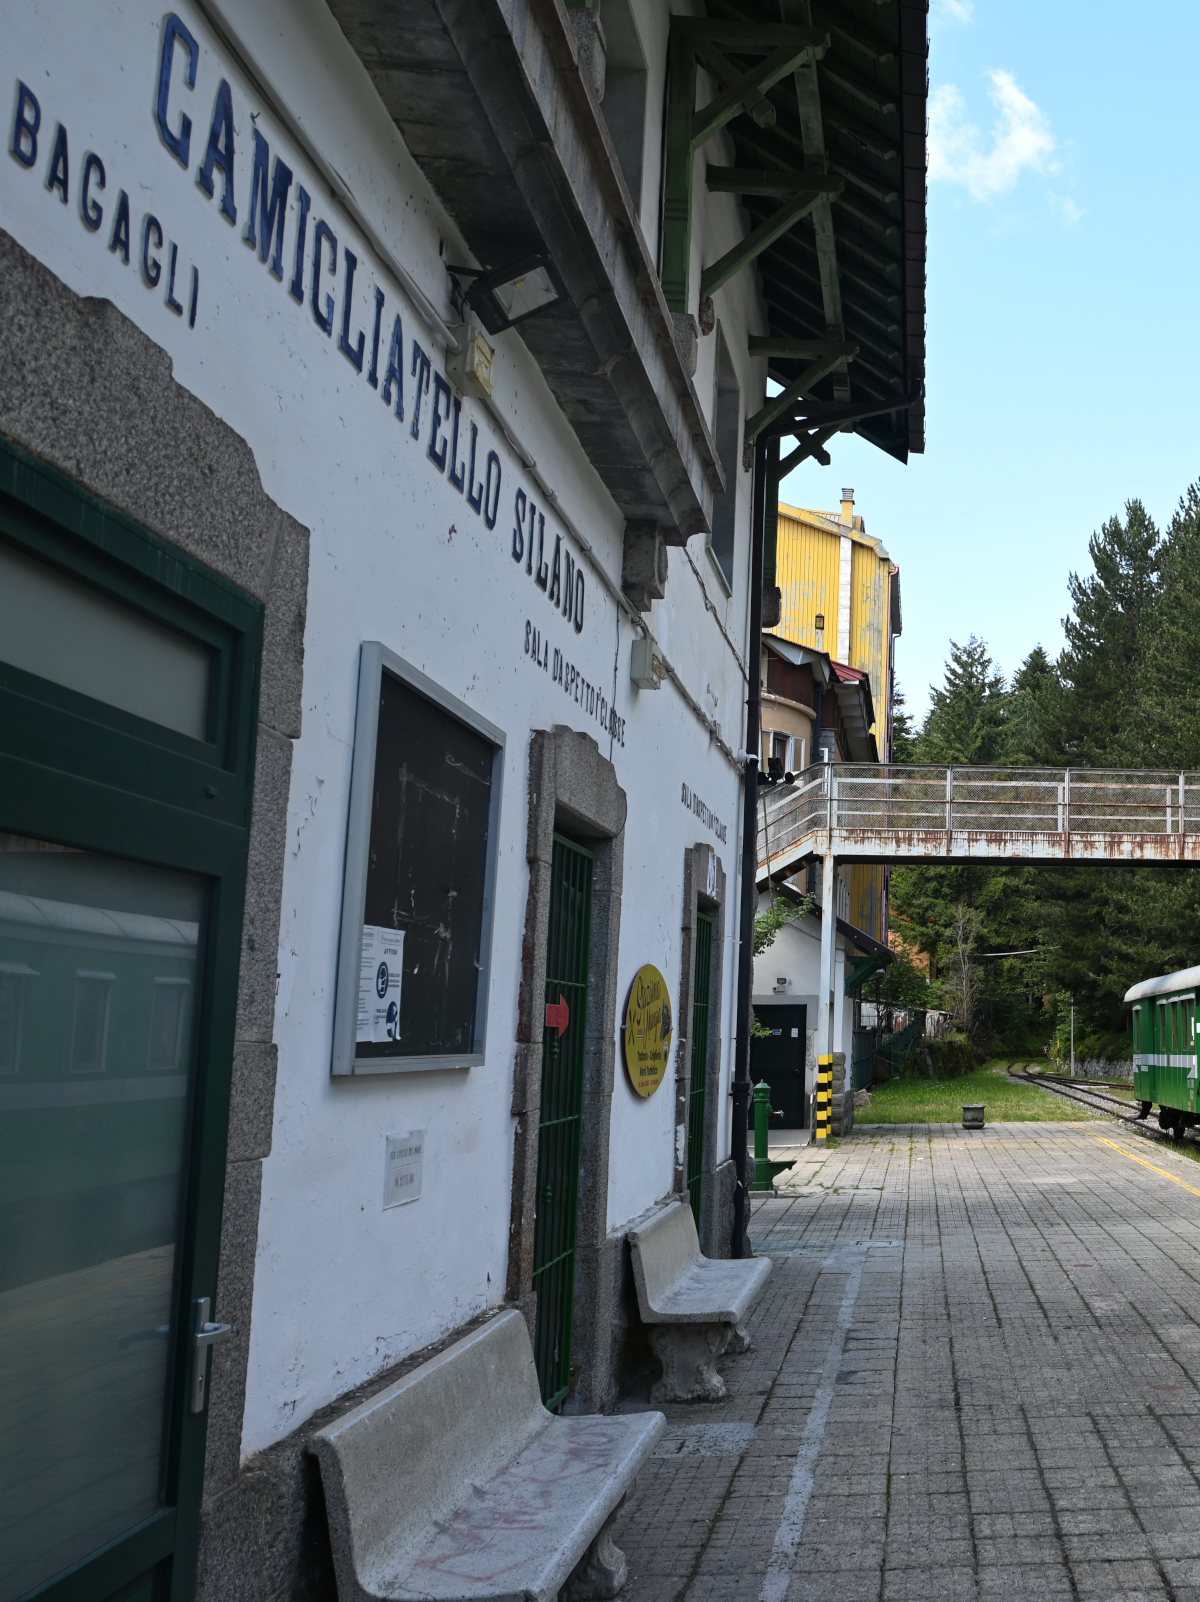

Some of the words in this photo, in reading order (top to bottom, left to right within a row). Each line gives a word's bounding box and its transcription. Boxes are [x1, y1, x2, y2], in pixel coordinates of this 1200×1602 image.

[10, 79, 199, 330] BAGAGLI
[155, 12, 502, 531] CAMIGLIATELLO
[512, 487, 586, 634] SILANO
[524, 619, 549, 673] SALA
[552, 647, 595, 716] D'ASPETTO
